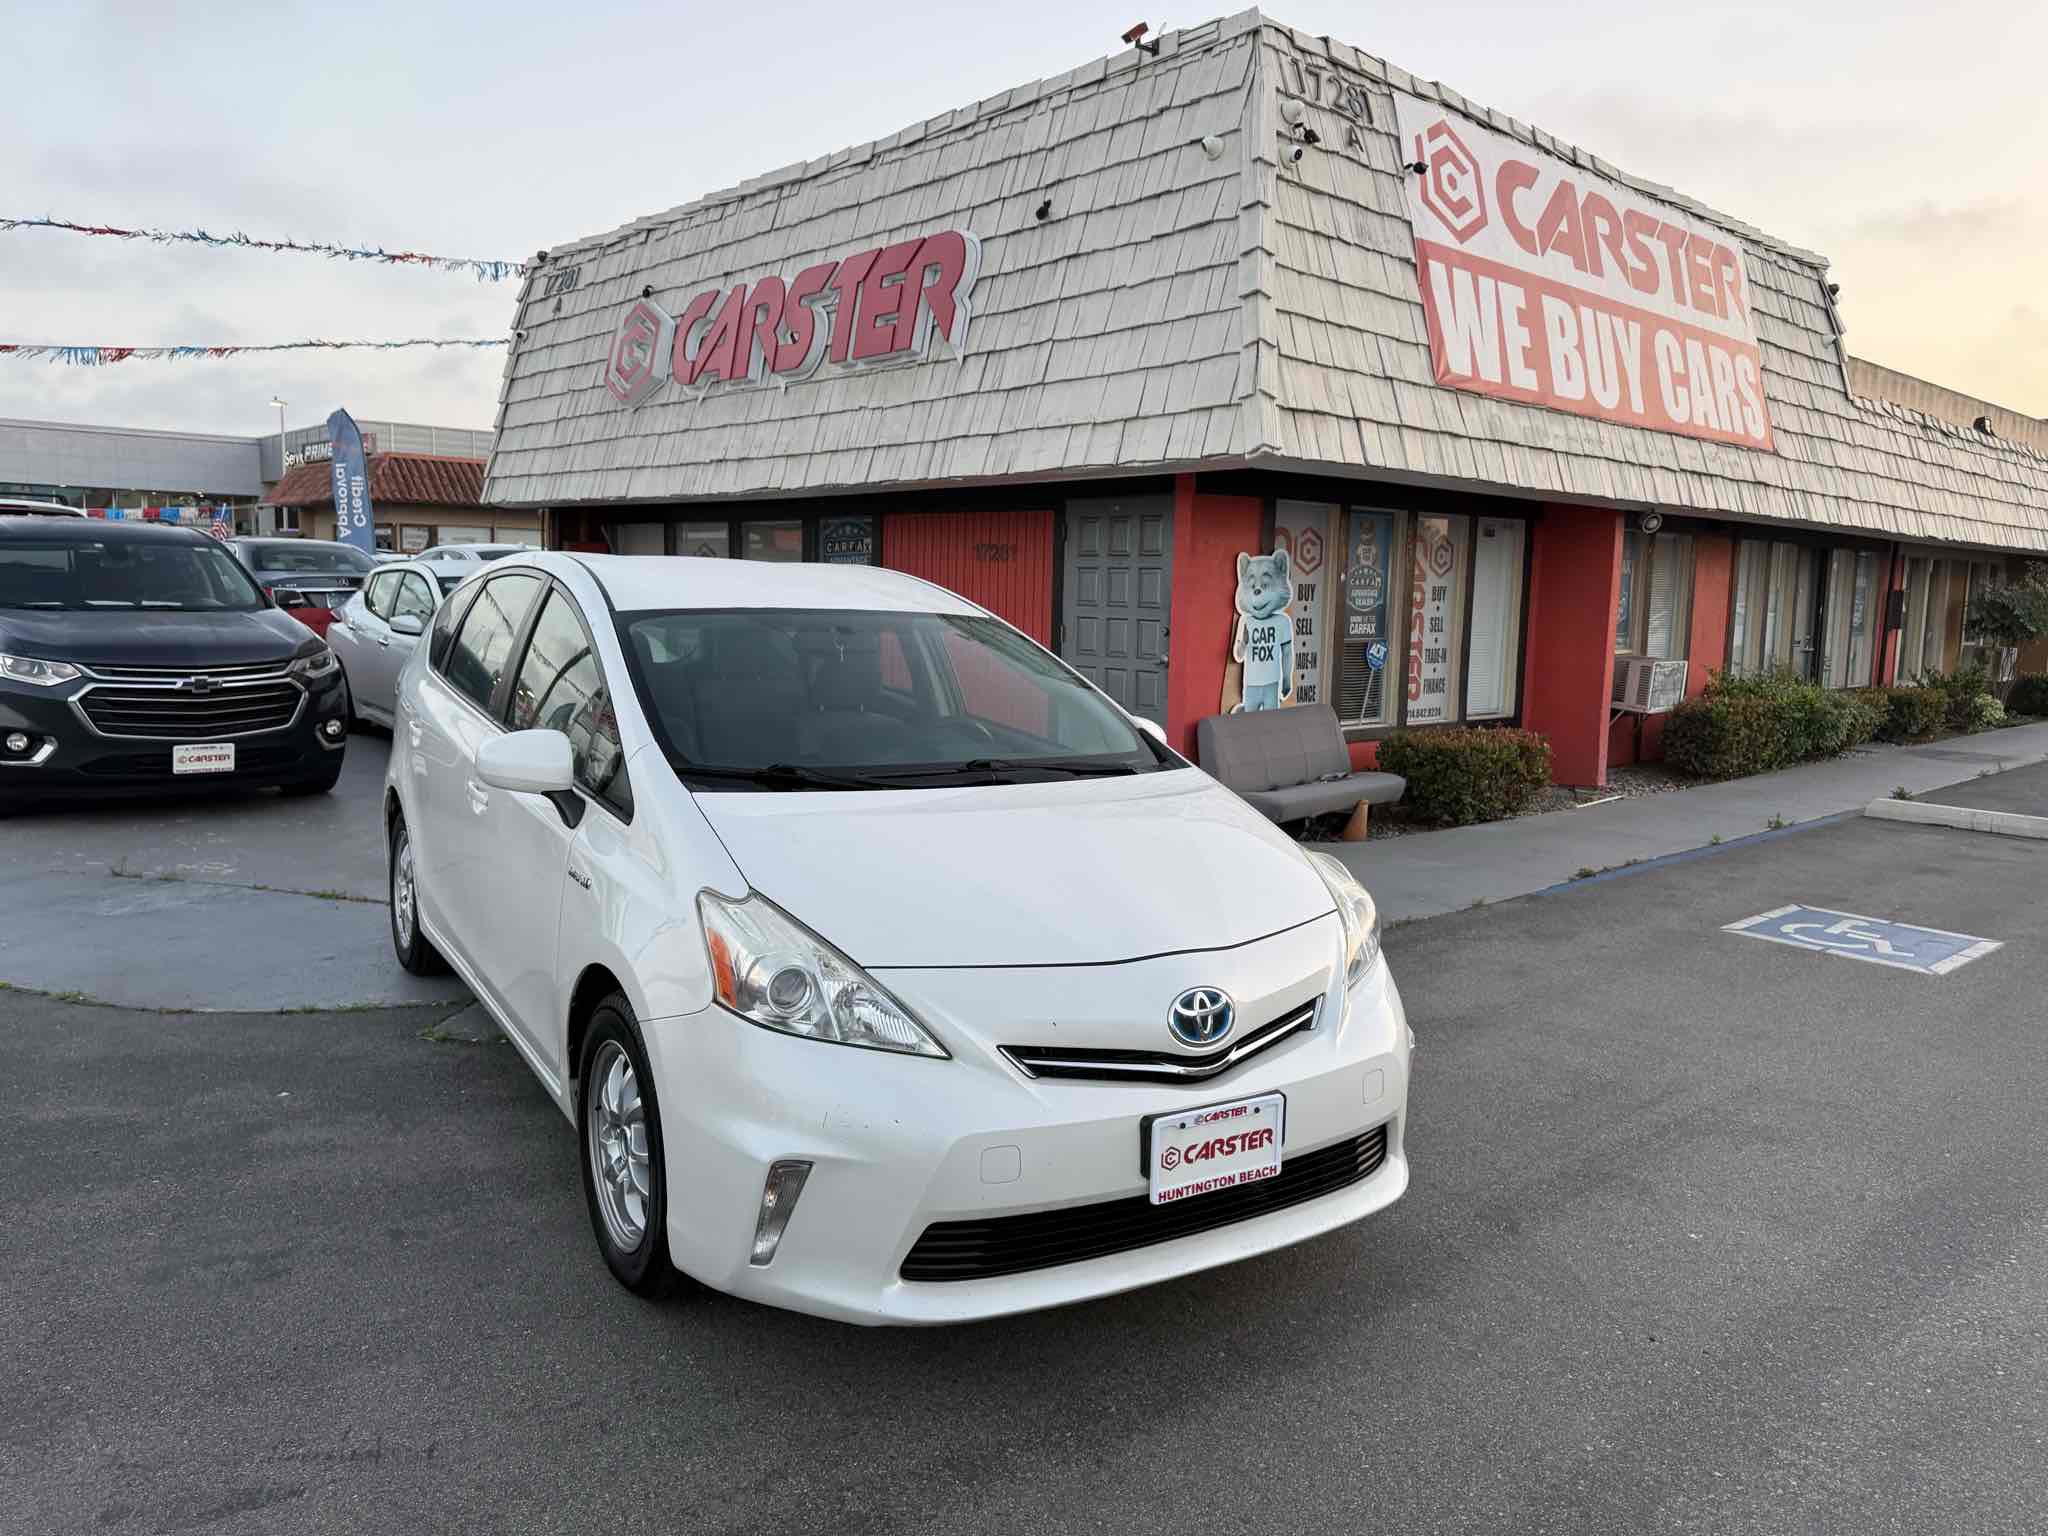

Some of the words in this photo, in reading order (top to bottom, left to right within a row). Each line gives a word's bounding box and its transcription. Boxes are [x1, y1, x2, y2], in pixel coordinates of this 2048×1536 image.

[1291, 58, 1373, 125] 17281
[1344, 125, 1364, 152] A
[1495, 159, 1752, 328] CARSTER
[672, 229, 974, 389] CARSTER
[1427, 259, 1539, 392] WE
[1541, 293, 1645, 416] BUY
[1653, 328, 1766, 440] CARS
[1298, 583, 1316, 601] BUY
[1432, 586, 1447, 602] BUY
[1296, 617, 1312, 635] SELL
[1429, 616, 1444, 632] SELL
[1252, 626, 1276, 644] CAR
[1252, 645, 1274, 662] FOX
[1424, 648, 1447, 664] TRADE-IN
[1423, 678, 1446, 694] FINANCE
[1204, 1105, 1248, 1123] CARSTER
[1184, 1128, 1274, 1164] CARSTER
[1158, 1174, 1236, 1203] HUNTINGTON
[1239, 1165, 1278, 1182] BEACH
